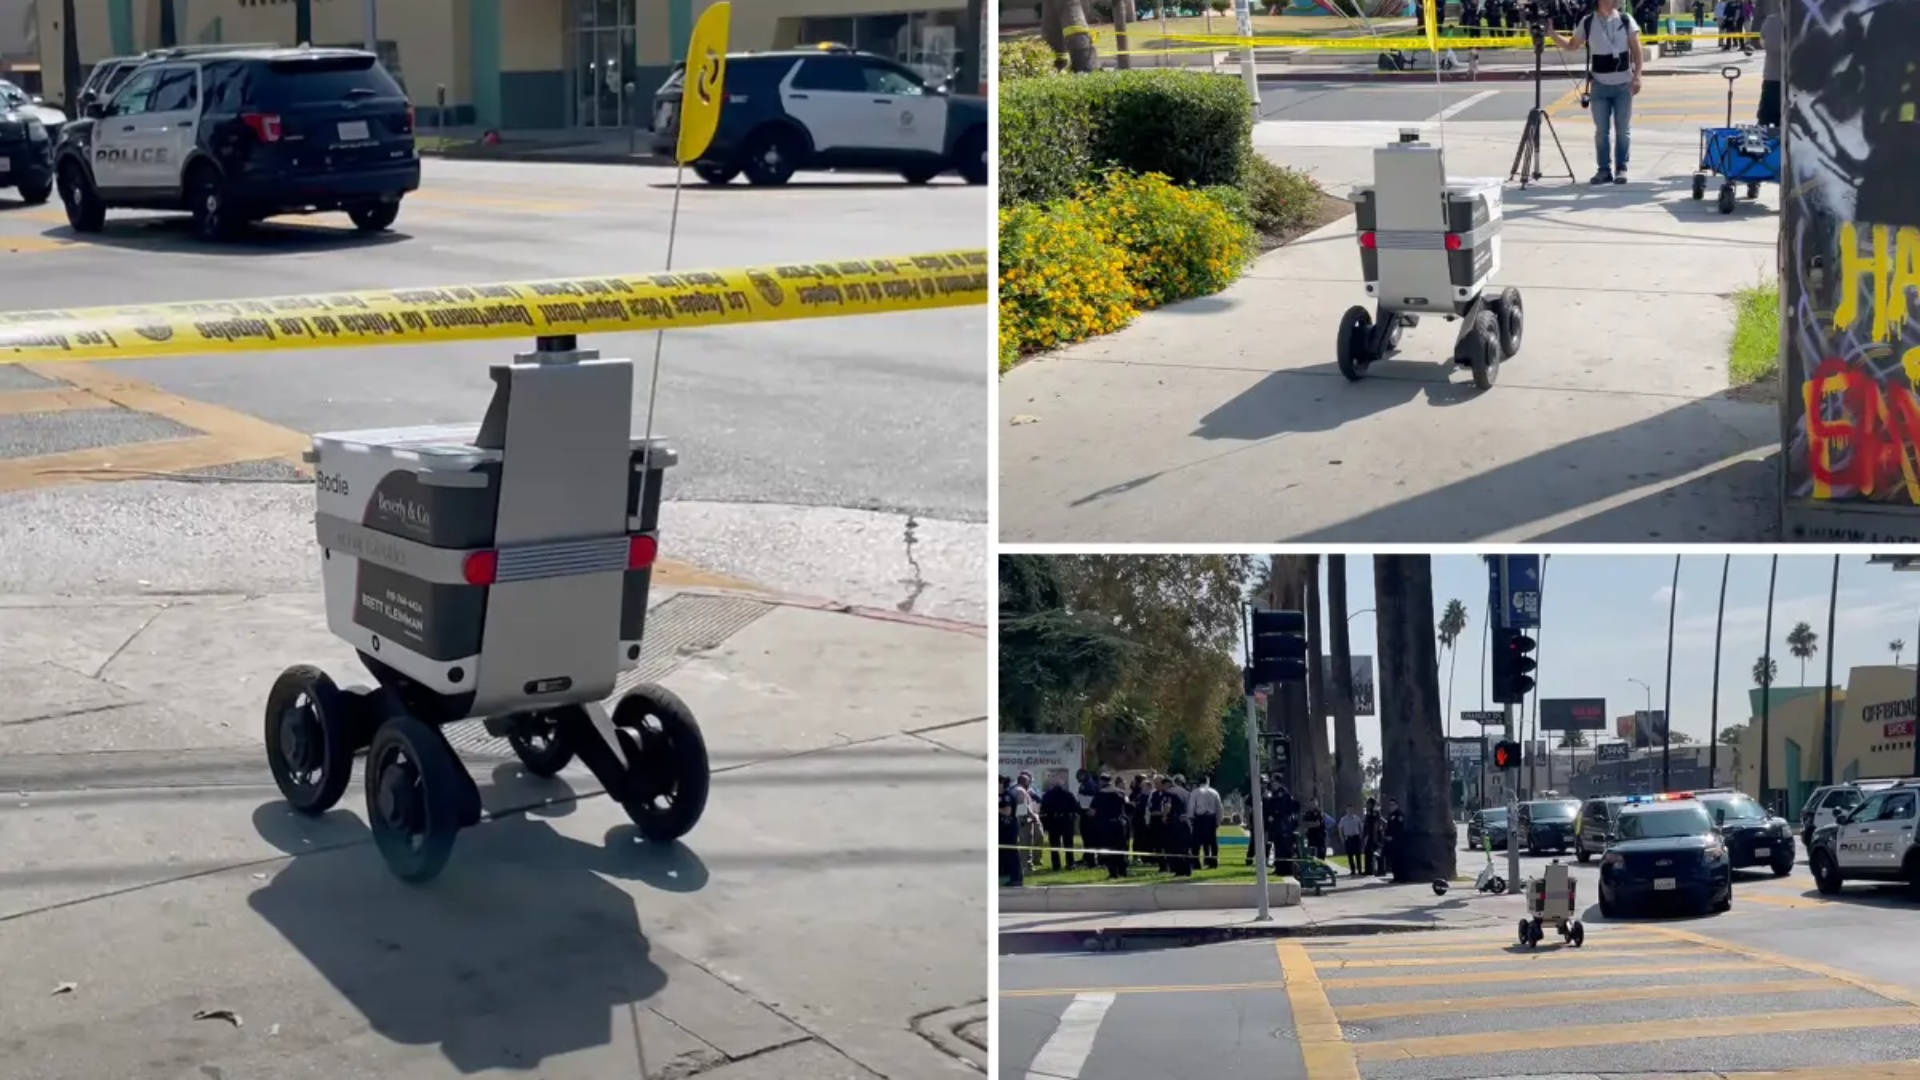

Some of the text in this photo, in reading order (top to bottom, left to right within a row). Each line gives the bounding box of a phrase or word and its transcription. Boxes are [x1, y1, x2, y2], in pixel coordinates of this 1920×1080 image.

[95, 147, 169, 165] POLICE
[537, 291, 751, 324] Los Angeles Police Department
[193, 317, 277, 342] Angeles
[274, 317, 317, 337] Los
[311, 316, 340, 336] de
[399, 312, 426, 330] de
[316, 470, 349, 496] Bodie
[378, 491, 406, 521] Beverly
[407, 502, 415, 520] &
[362, 593, 423, 631] BRETT KLEINMAN
[1839, 842, 1894, 853] POLICE
